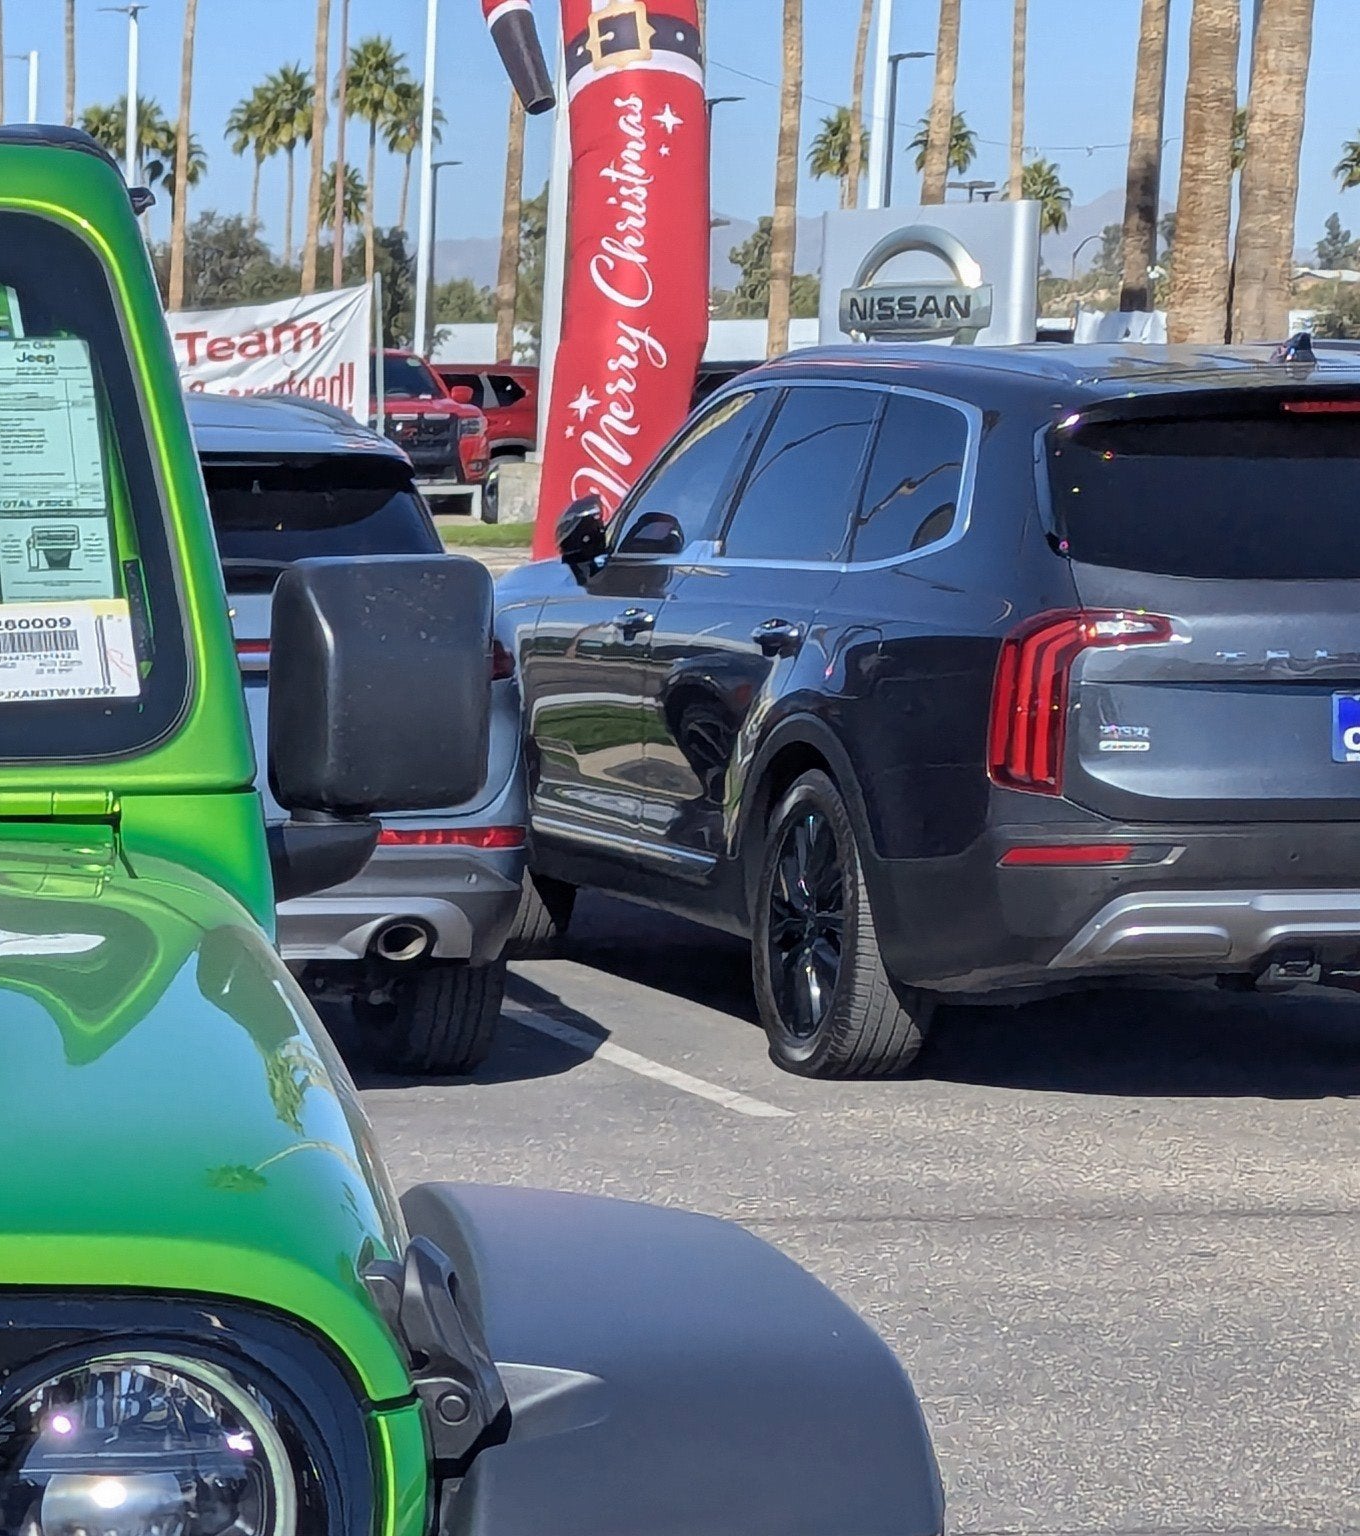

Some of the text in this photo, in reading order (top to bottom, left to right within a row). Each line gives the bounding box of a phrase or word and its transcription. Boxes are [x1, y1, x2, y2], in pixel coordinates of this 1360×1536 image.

[571, 93, 668, 510] Merry Christmas
[849, 295, 972, 321] NISSAN
[175, 321, 322, 366] Team
[15, 352, 56, 365] Jeep
[37, 499, 74, 508] PRICE
